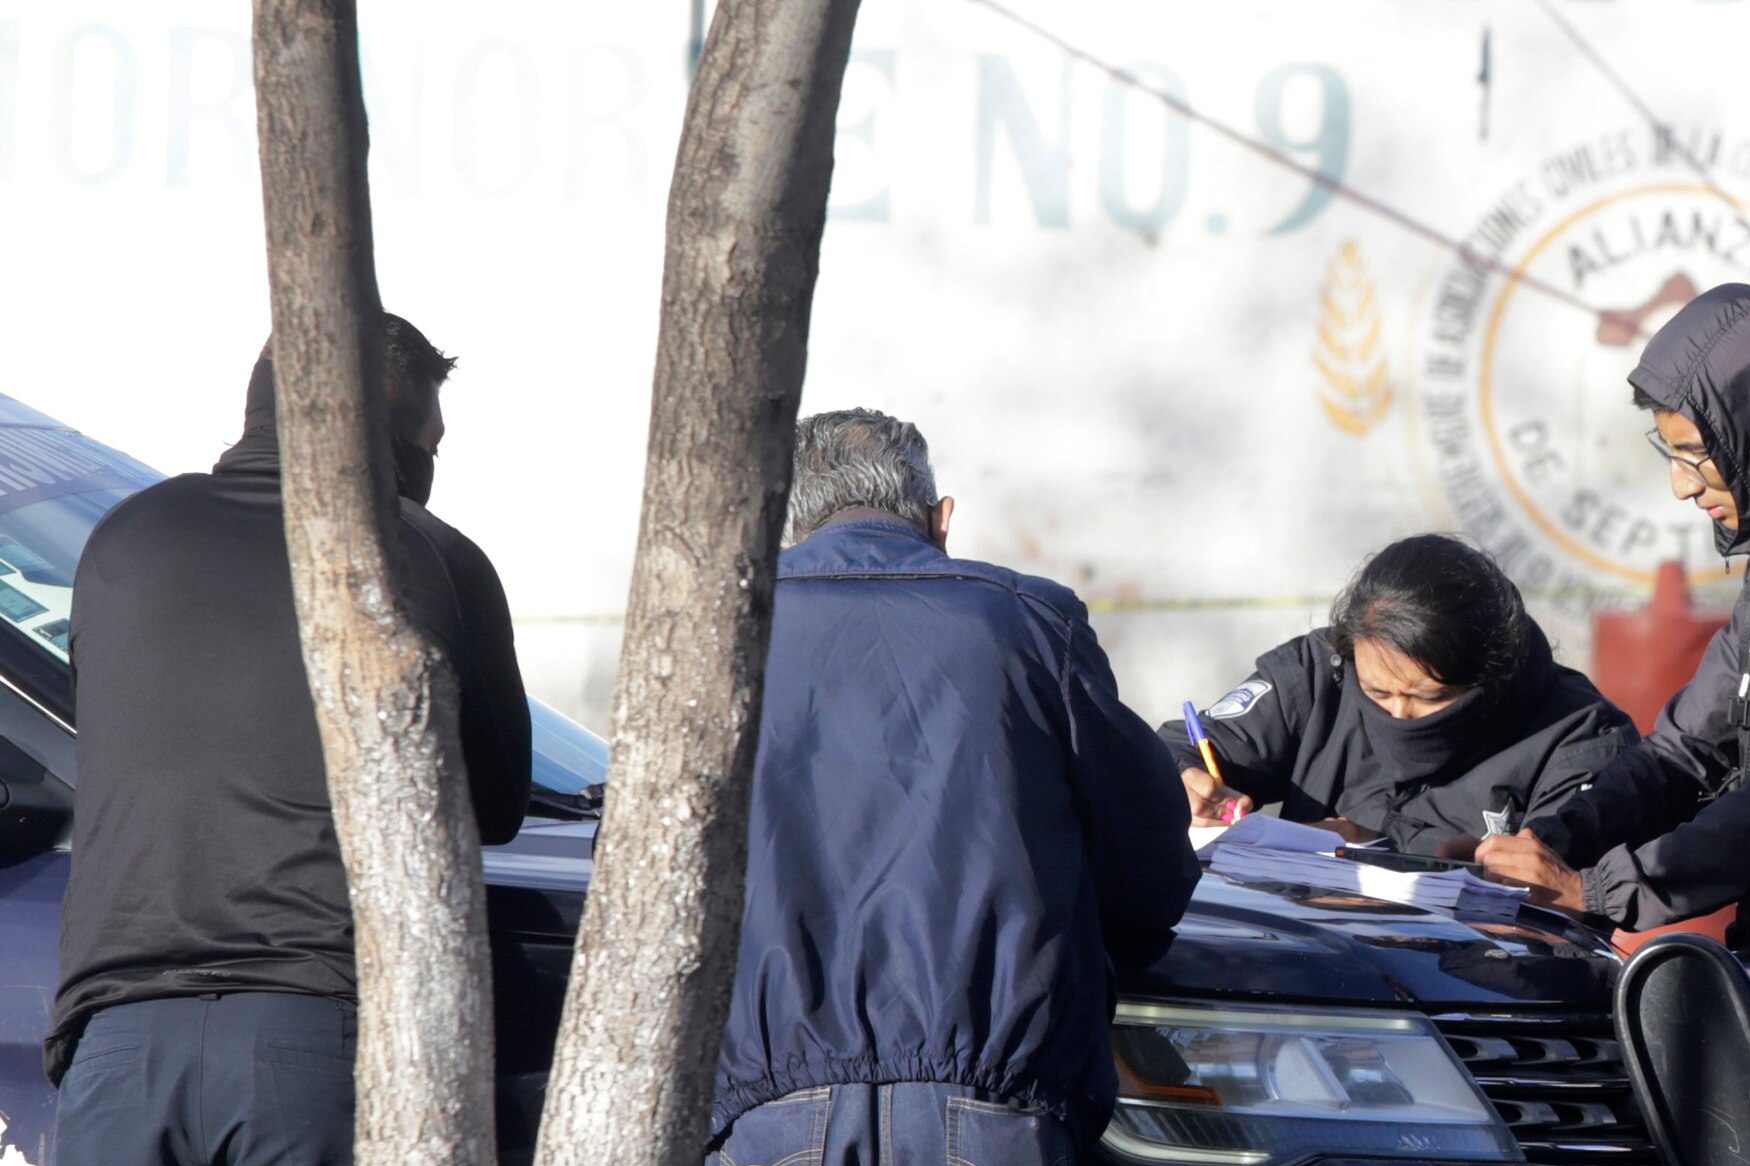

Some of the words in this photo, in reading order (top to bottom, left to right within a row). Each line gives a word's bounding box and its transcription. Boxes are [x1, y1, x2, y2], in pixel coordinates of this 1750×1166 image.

[0, 18, 258, 190] OR
[360, 31, 897, 224] NORE
[1508, 419, 1567, 488] DE
